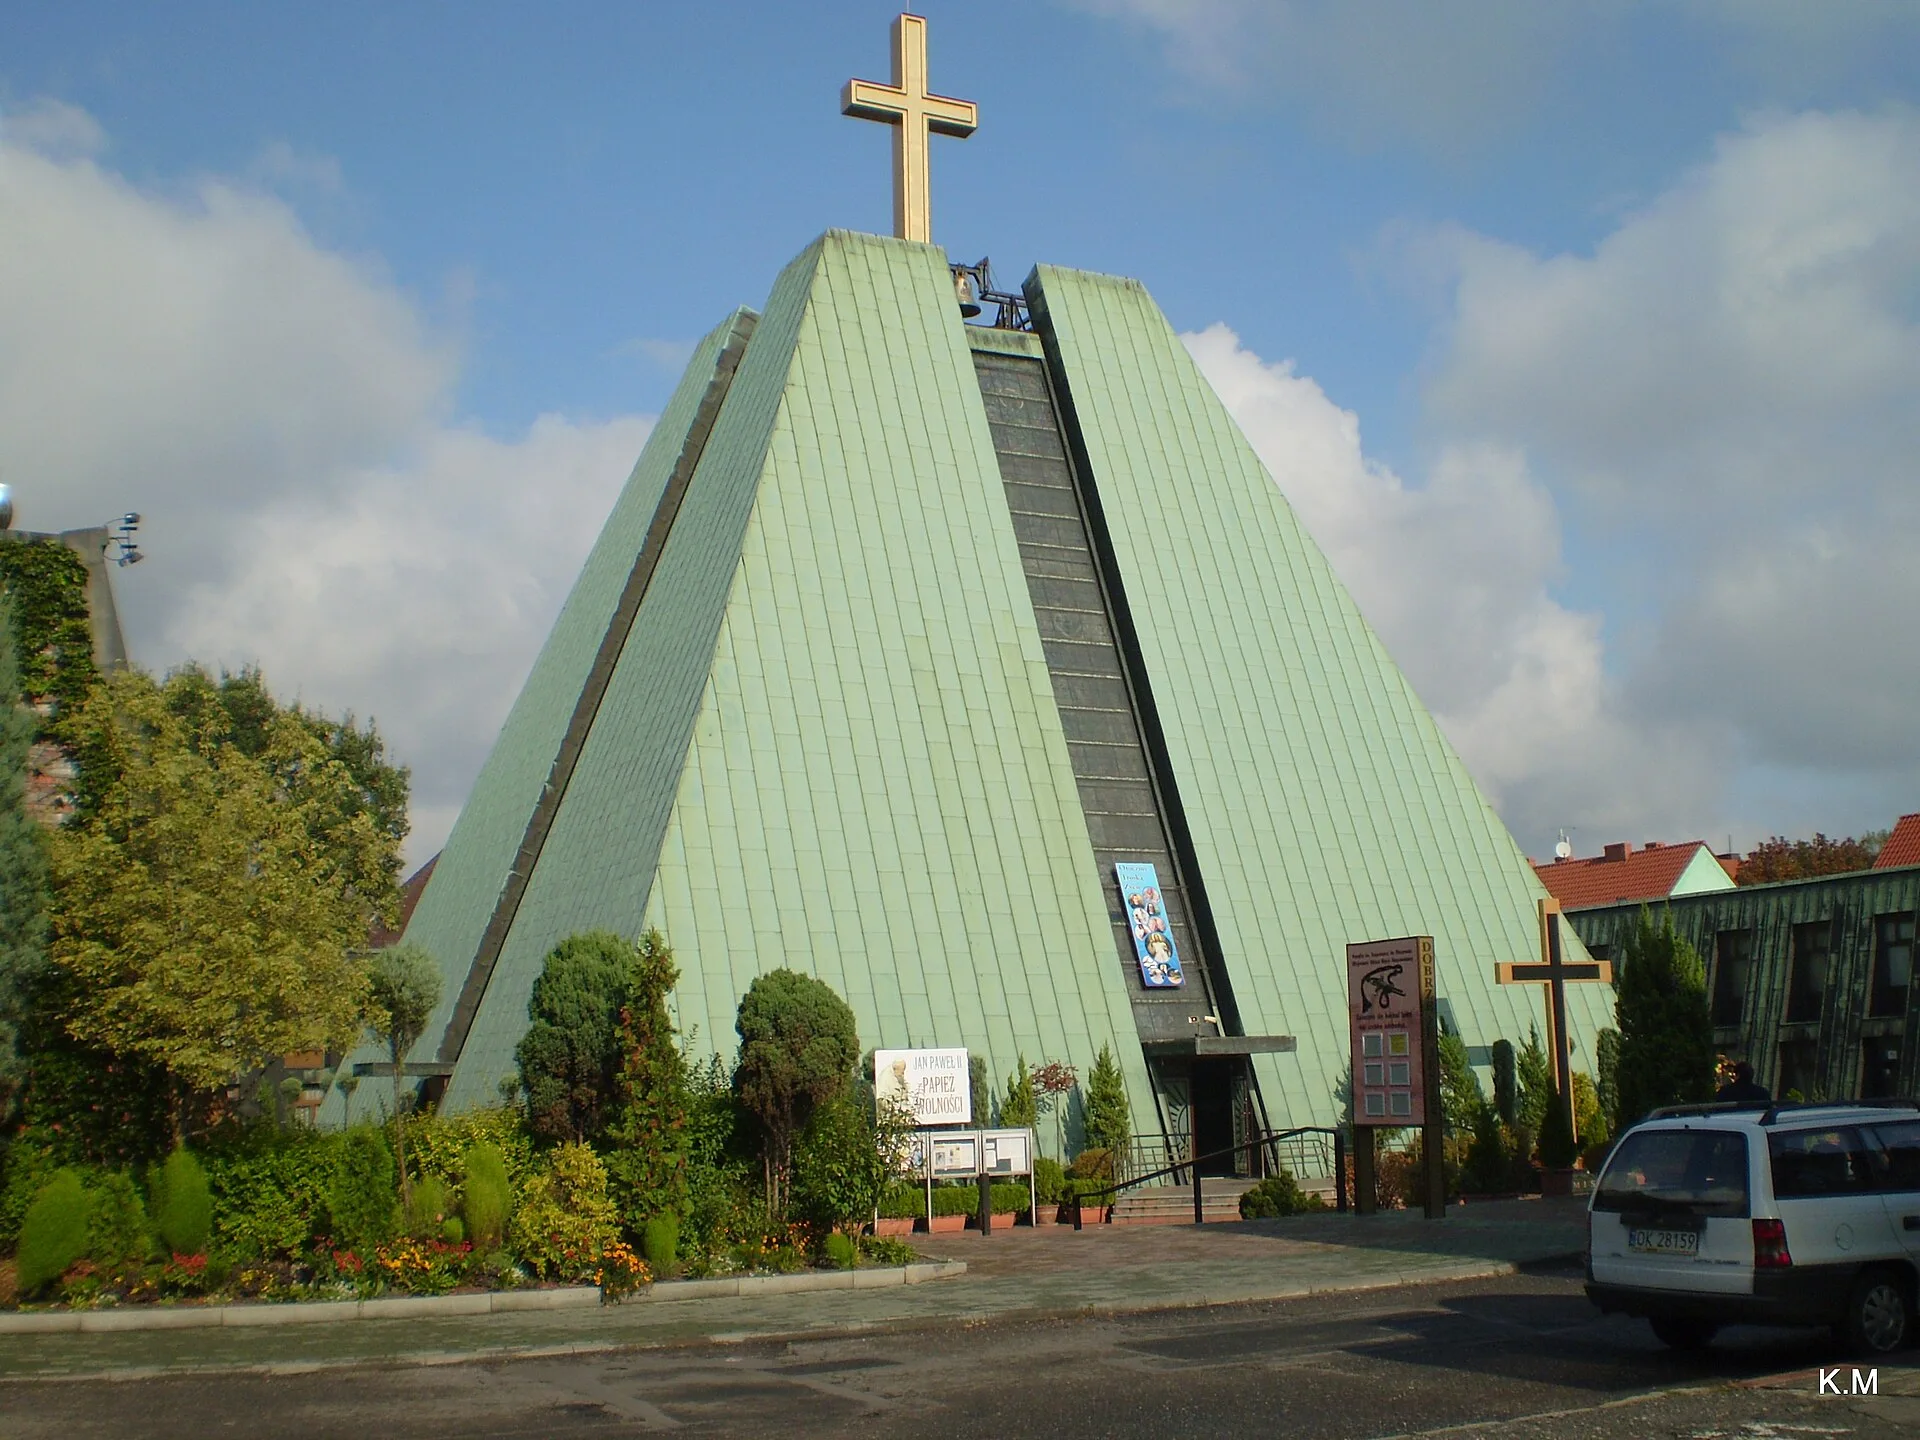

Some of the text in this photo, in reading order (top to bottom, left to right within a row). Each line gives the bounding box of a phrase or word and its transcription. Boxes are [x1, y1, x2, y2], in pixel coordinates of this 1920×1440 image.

[913, 1055, 963, 1070] JAN PAWEŁ II
[922, 1073, 956, 1093] PAPIEŻ
[1636, 1231, 1696, 1249] OK 28159
